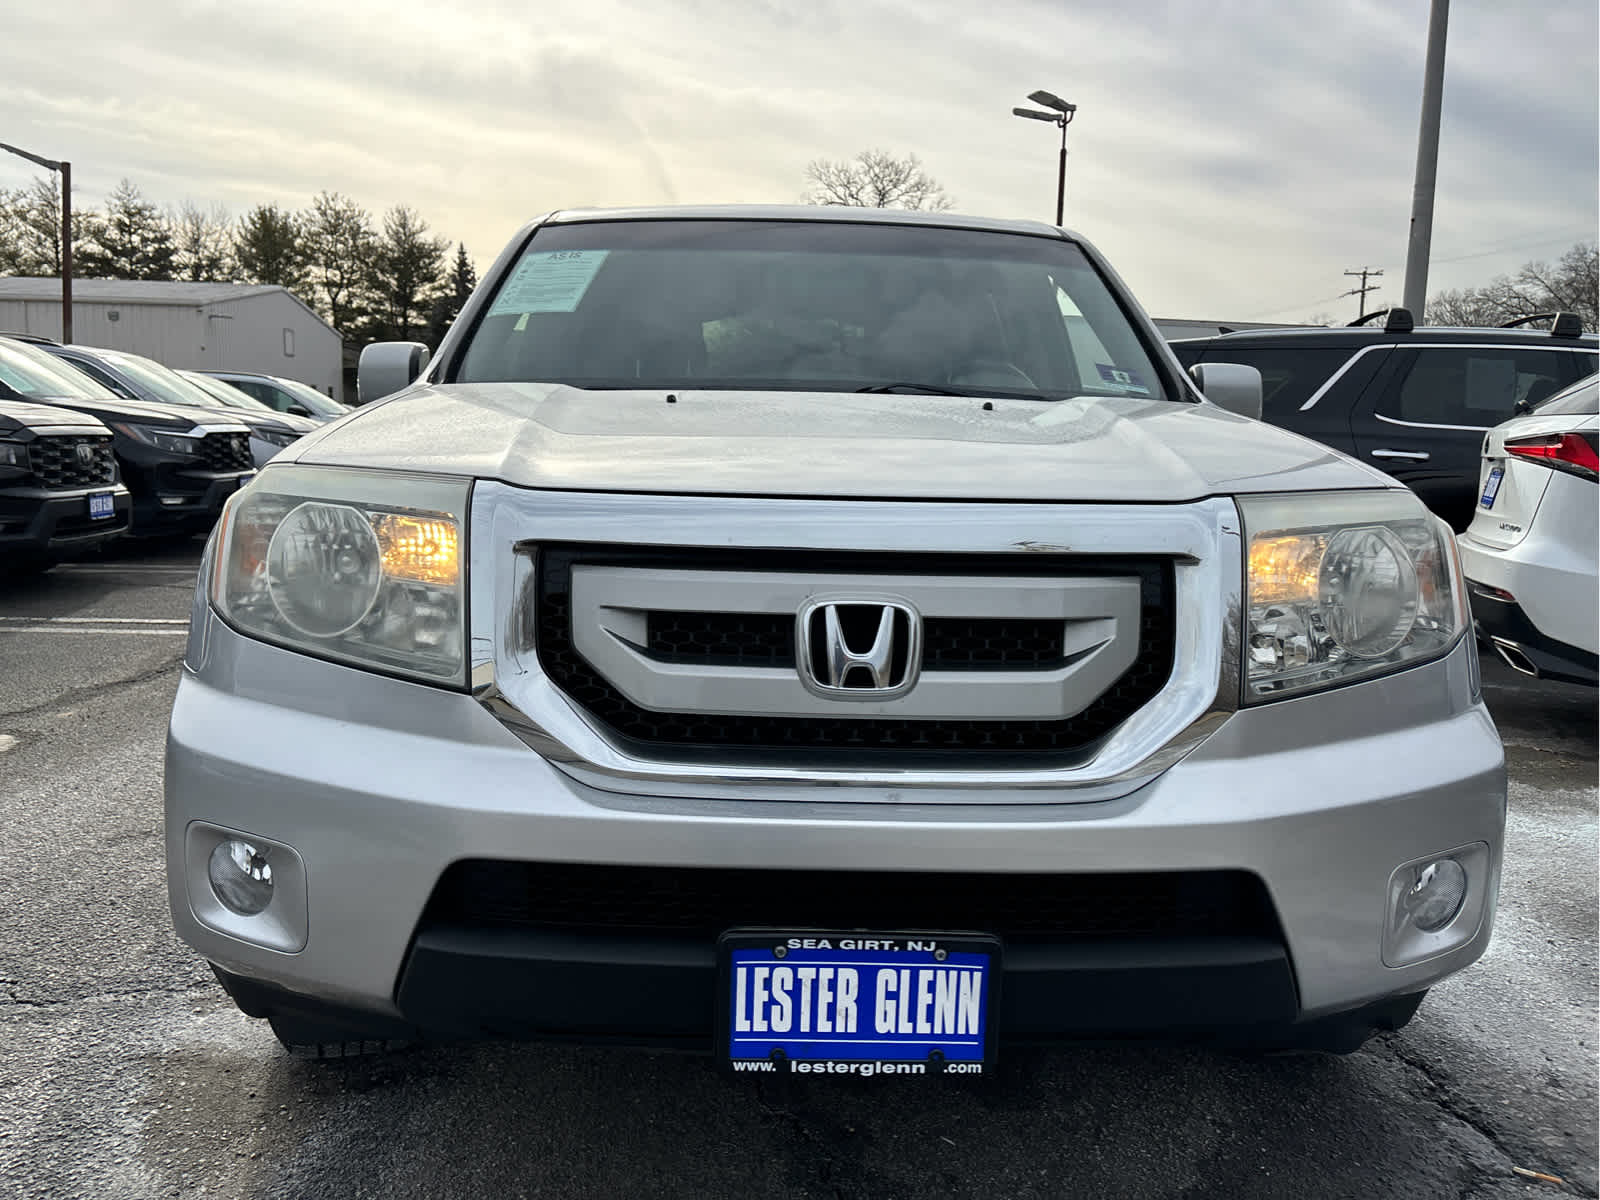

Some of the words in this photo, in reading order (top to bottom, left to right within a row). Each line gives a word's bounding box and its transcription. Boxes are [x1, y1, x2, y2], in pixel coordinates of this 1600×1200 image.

[786, 938, 833, 950] SEA
[839, 939, 899, 952] GIRT,
[906, 941, 937, 952] NJ
[735, 966, 859, 1033] LESTER
[874, 968, 983, 1035] GLENN
[732, 1061, 777, 1072] www.
[790, 1060, 926, 1077] lesterglenn
[942, 1062, 983, 1074] .com
